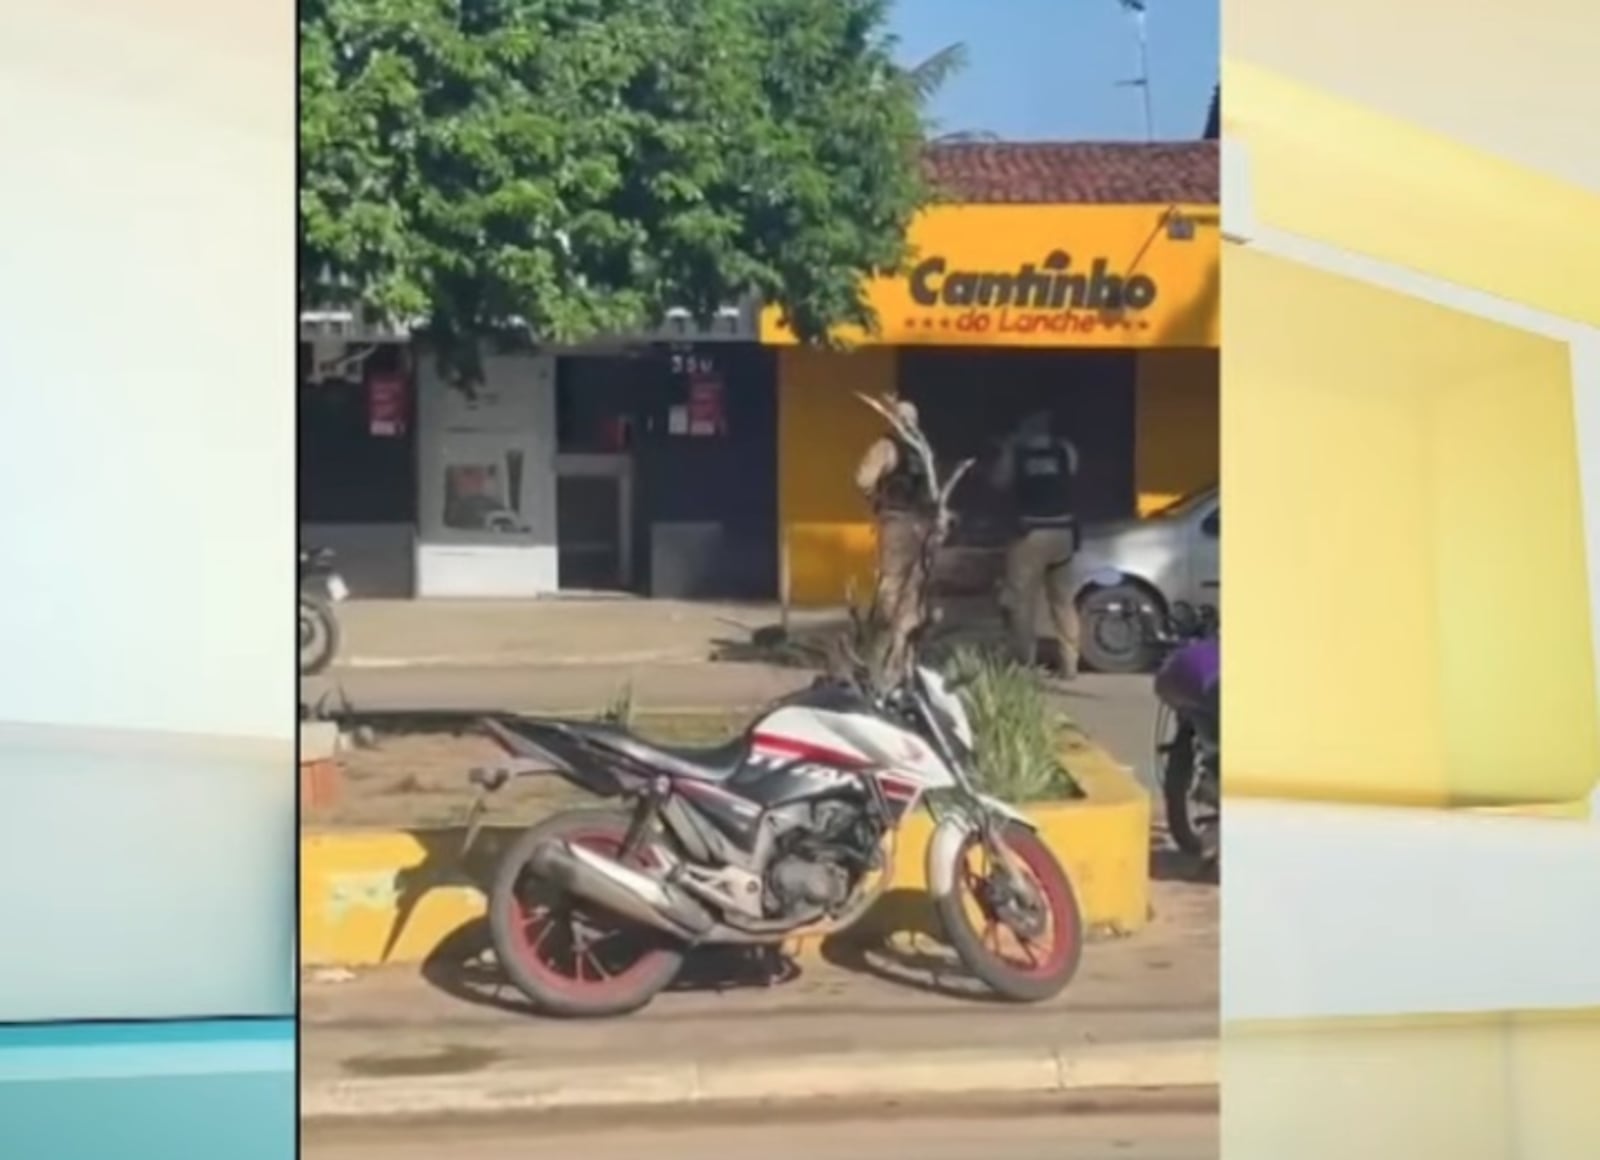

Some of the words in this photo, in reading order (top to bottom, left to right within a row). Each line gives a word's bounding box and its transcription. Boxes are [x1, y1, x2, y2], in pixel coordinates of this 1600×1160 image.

[909, 250, 1156, 310] Cantinho
[956, 307, 991, 333] do
[998, 307, 1095, 334] Lanche
